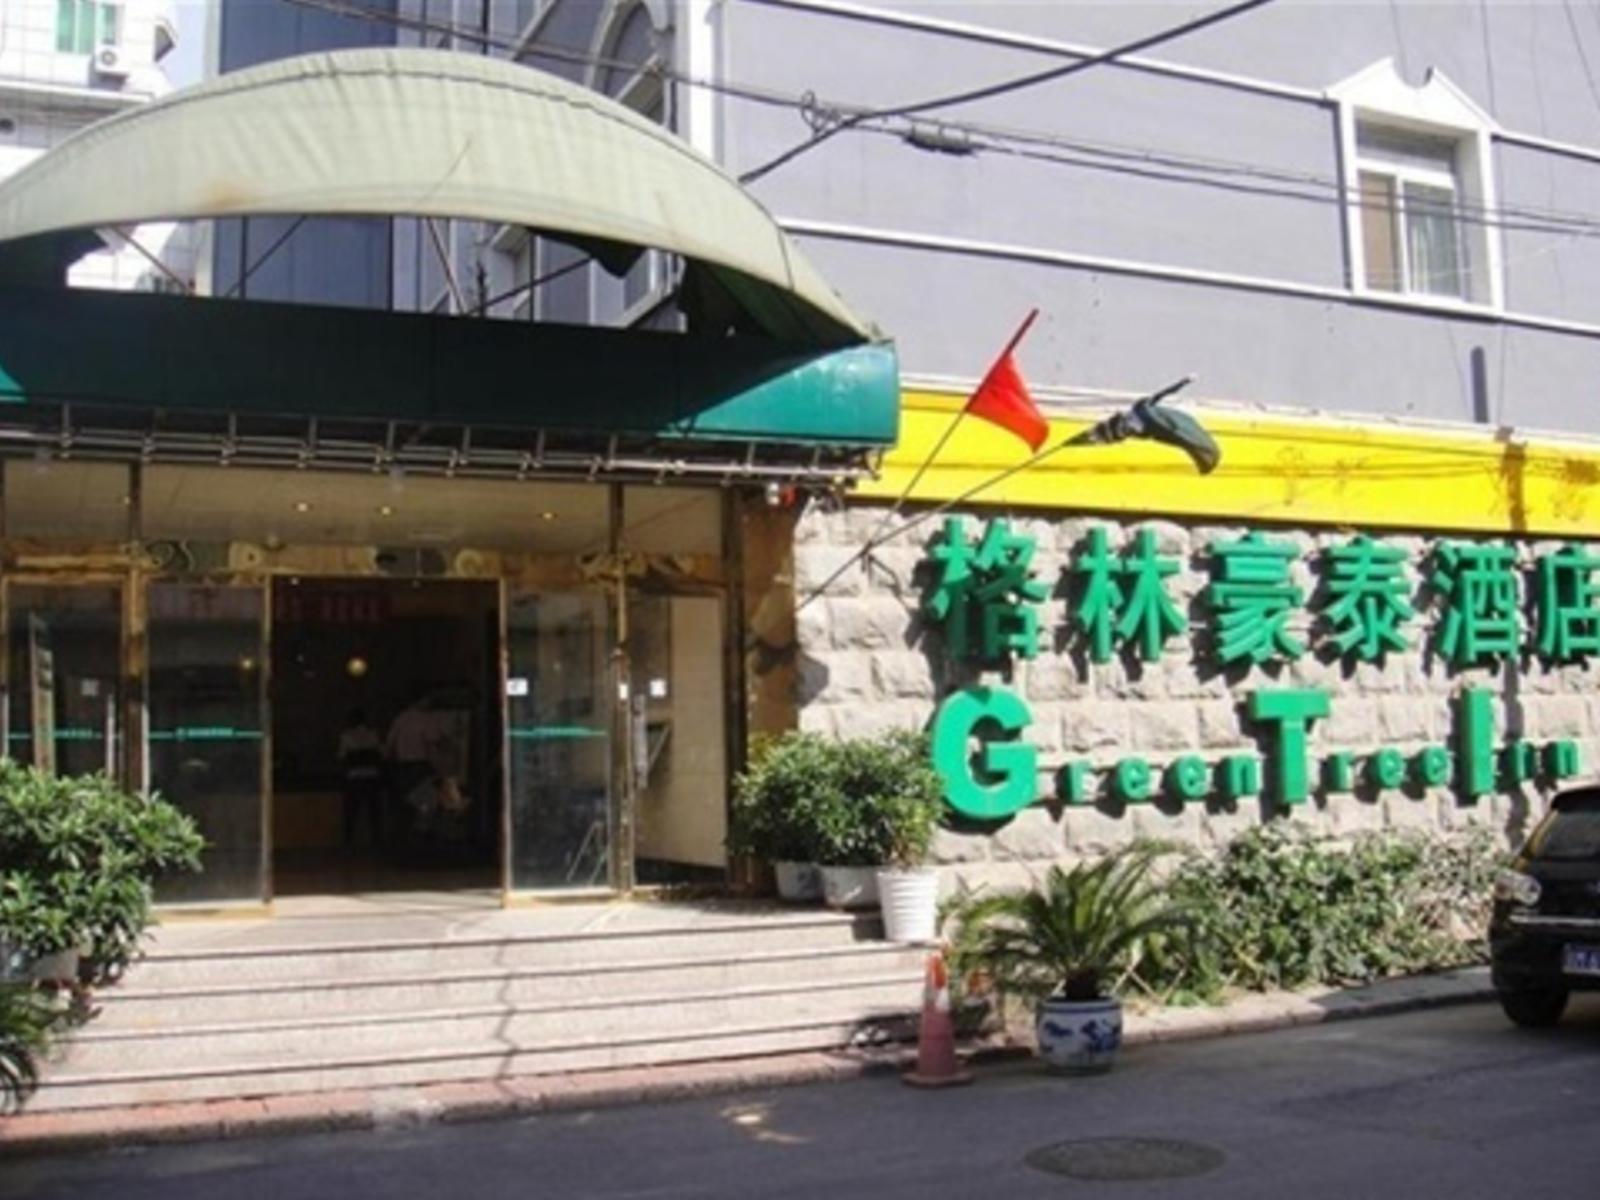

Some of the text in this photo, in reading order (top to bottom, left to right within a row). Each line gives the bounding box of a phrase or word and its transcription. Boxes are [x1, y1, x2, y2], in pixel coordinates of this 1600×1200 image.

[930, 514, 1600, 665] 格林豪泰酒店
